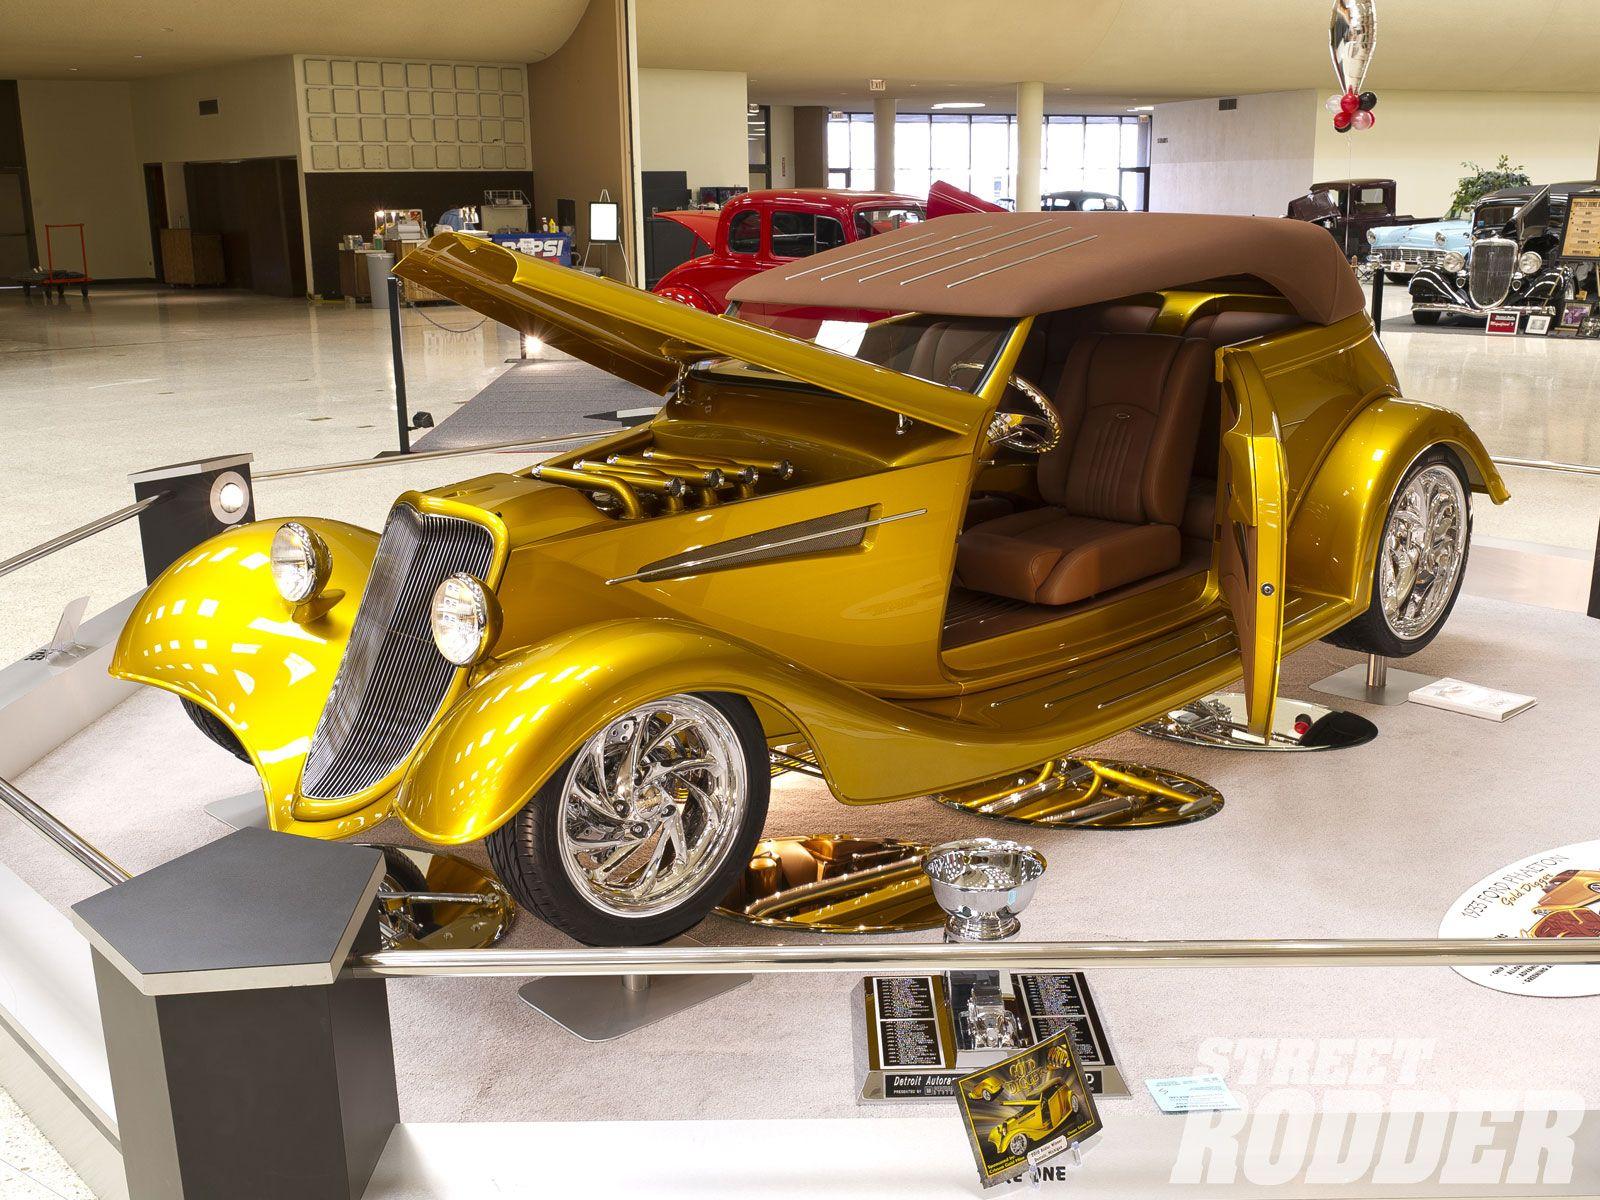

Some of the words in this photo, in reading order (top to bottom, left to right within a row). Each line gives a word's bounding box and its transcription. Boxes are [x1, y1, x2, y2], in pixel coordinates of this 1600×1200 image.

[871, 81, 885, 89] EXIT
[502, 240, 563, 257] PSI
[1477, 882, 1511, 903] FORD
[1503, 854, 1569, 884] PHAETON
[1501, 887, 1525, 906] Gold
[1521, 873, 1554, 892] Digger
[894, 1076, 921, 1086] Detroit
[925, 1076, 958, 1086] Autora
